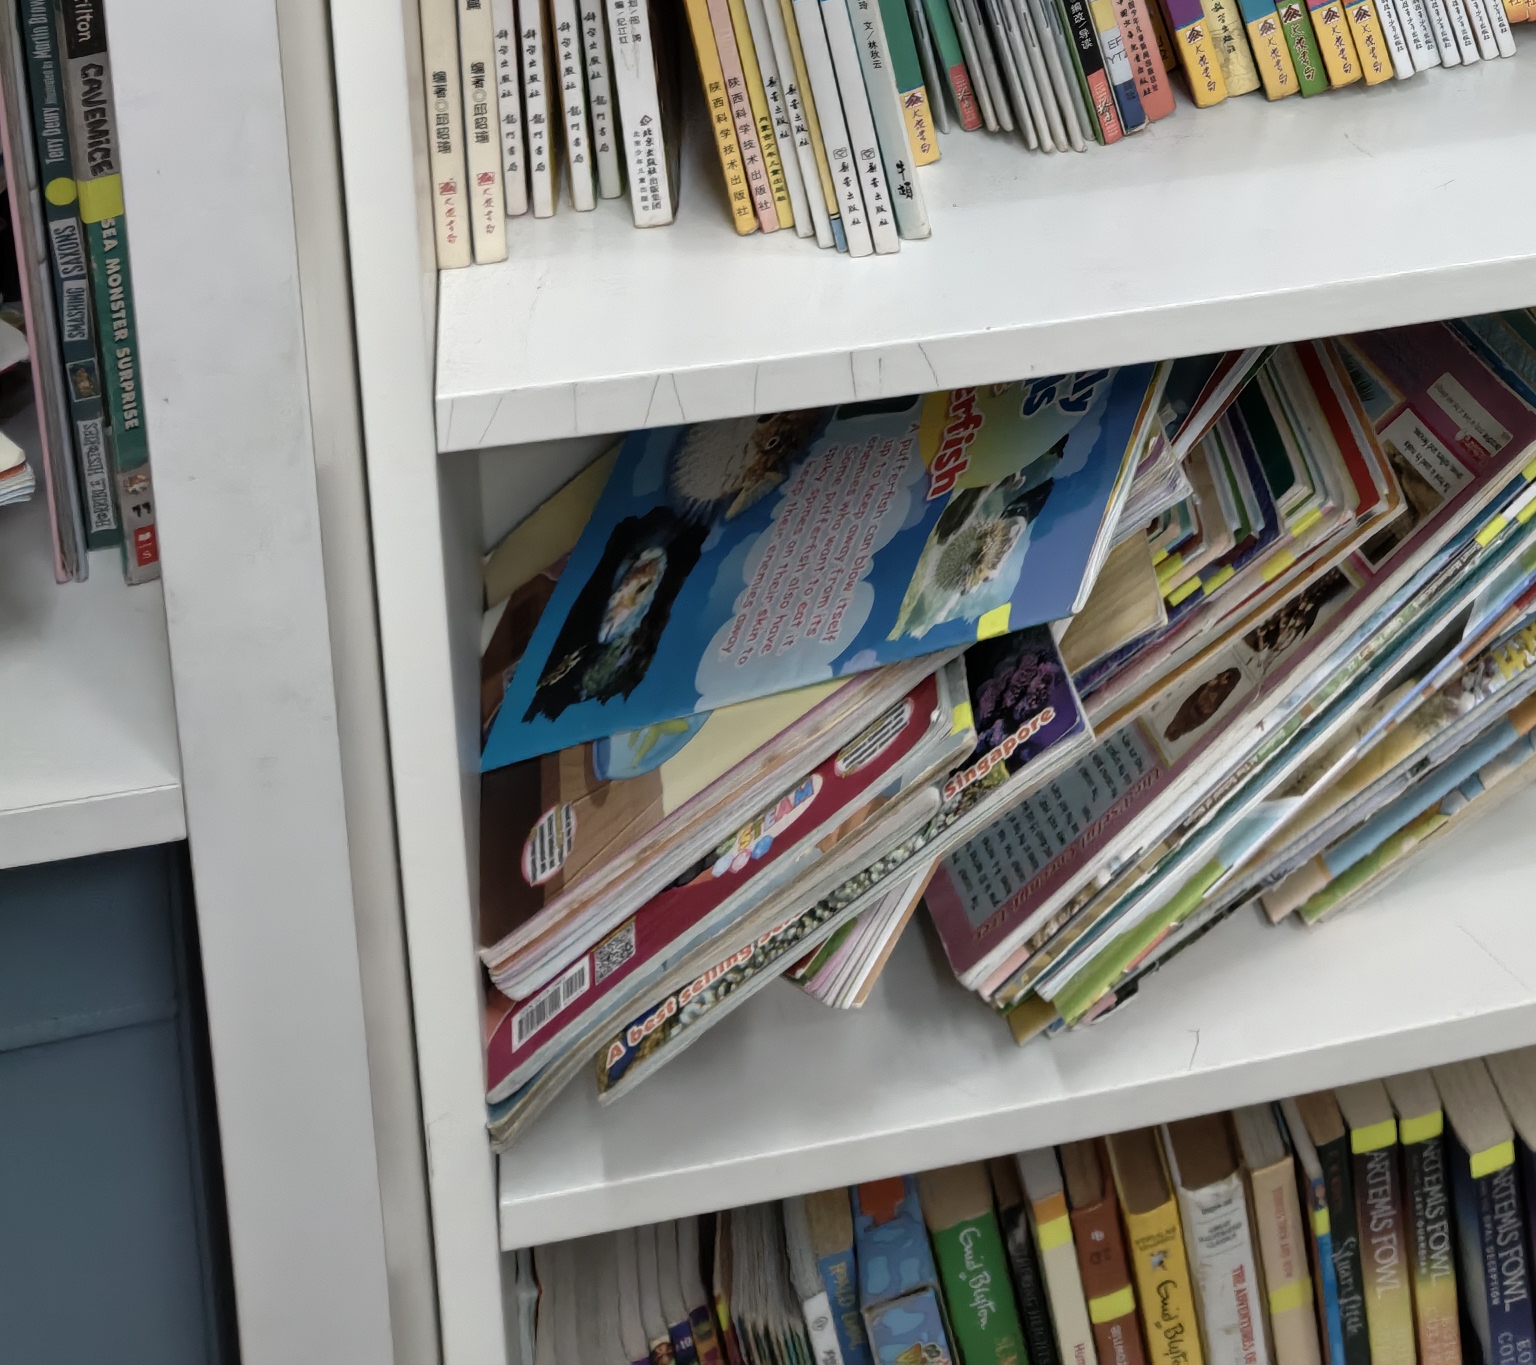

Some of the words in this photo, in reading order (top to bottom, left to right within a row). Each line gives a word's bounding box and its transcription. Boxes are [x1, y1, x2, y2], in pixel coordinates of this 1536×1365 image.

[82, 63, 114, 178] CAVEMICE
[105, 257, 128, 340] MONSTER
[114, 347, 140, 431] SURPRISE
[942, 706, 1057, 801] Singapore
[627, 1004, 676, 1046] best
[678, 943, 754, 1007] selling
